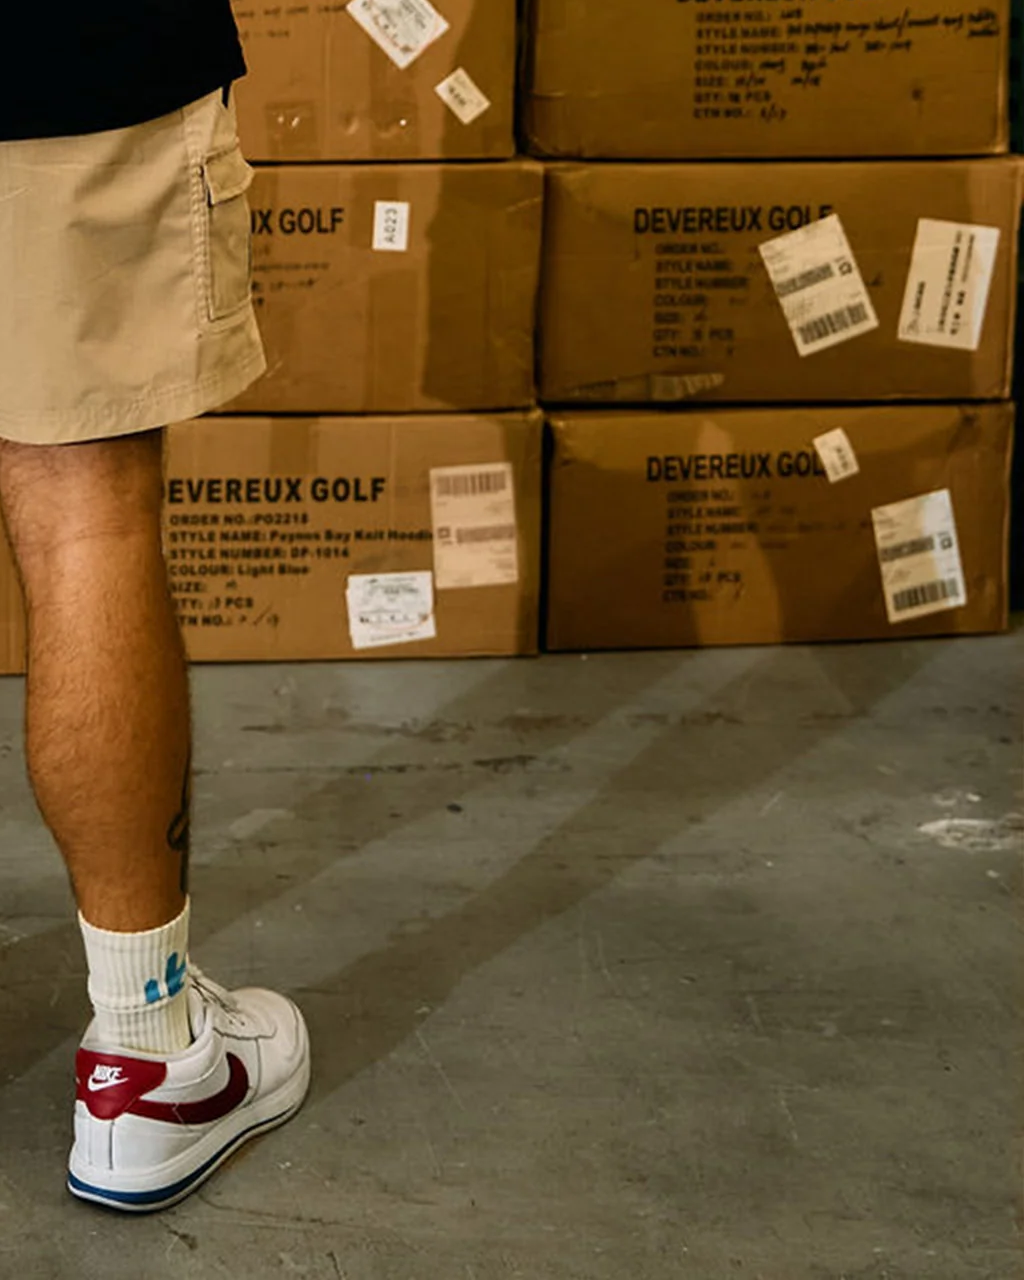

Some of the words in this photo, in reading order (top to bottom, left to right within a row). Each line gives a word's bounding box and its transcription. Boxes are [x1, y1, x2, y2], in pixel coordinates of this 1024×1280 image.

[279, 207, 345, 235] GOLF
[633, 207, 763, 234] DEVEREUX
[646, 453, 772, 482] DEVEREUX
[777, 451, 826, 477] GOL
[167, 477, 303, 505] EVEREUX
[310, 477, 387, 503] GOLF
[169, 514, 220, 526] ORDER
[169, 531, 215, 543] STYLE
[169, 548, 216, 560] STYLE
[219, 547, 286, 560] NUMBER:
